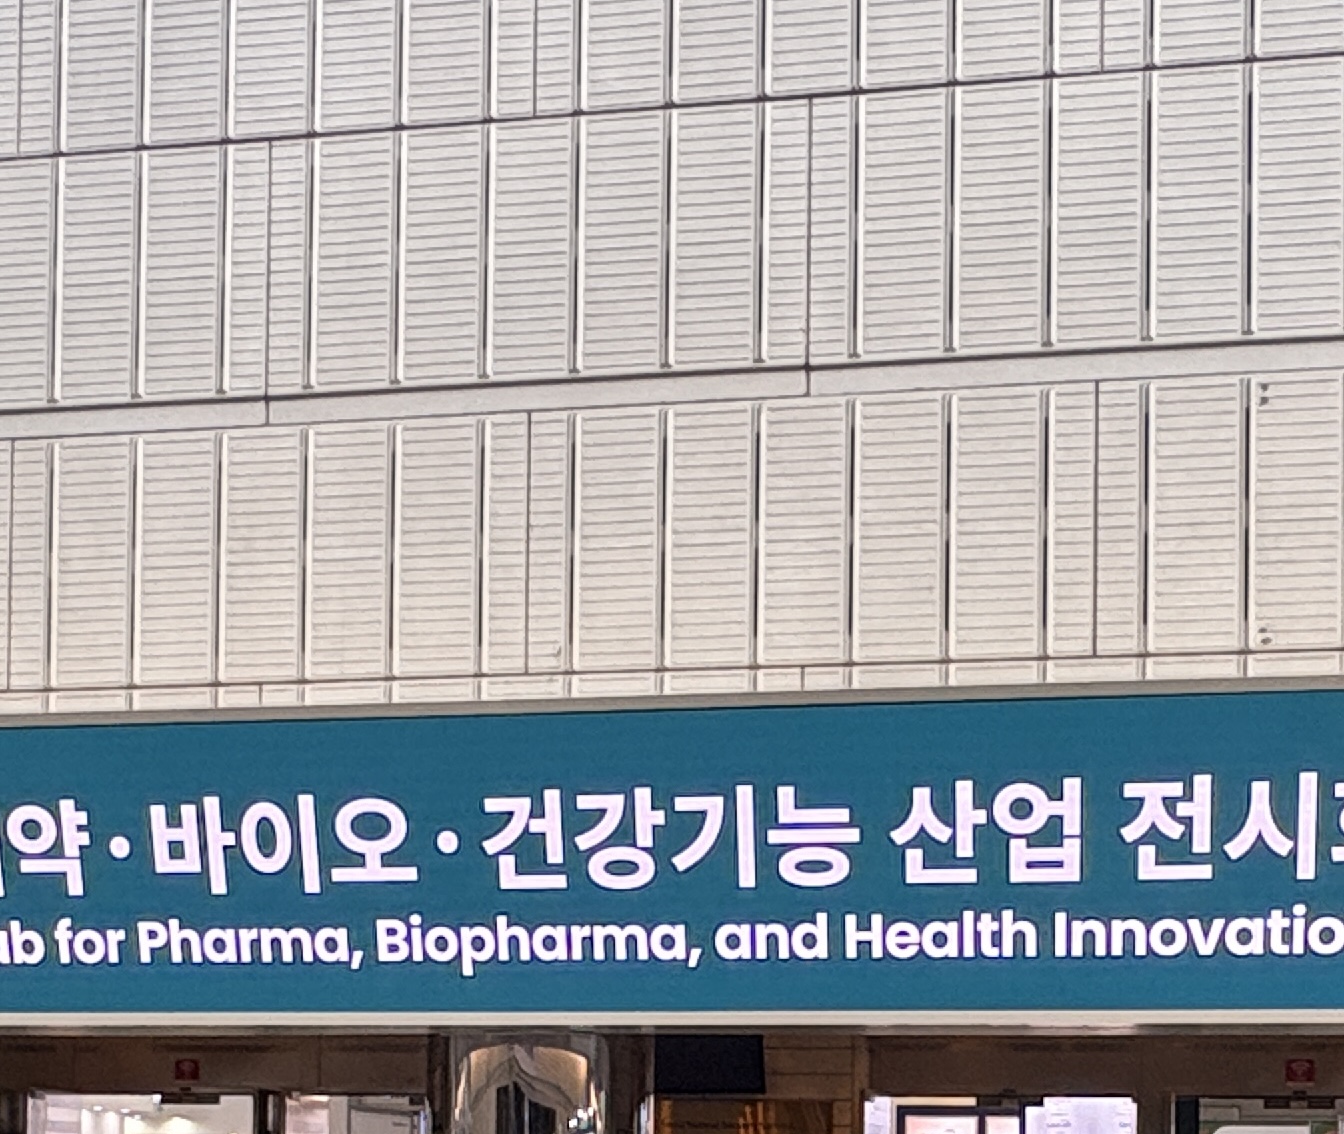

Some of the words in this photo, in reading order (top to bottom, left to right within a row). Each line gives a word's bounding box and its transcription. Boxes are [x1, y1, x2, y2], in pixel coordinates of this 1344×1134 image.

[889, 776, 1082, 884] 산업
[53, 917, 126, 964] for
[136, 918, 364, 970] Pharma,
[376, 913, 702, 977] Biopharma,
[714, 912, 828, 960] and
[844, 909, 1037, 959] Health
